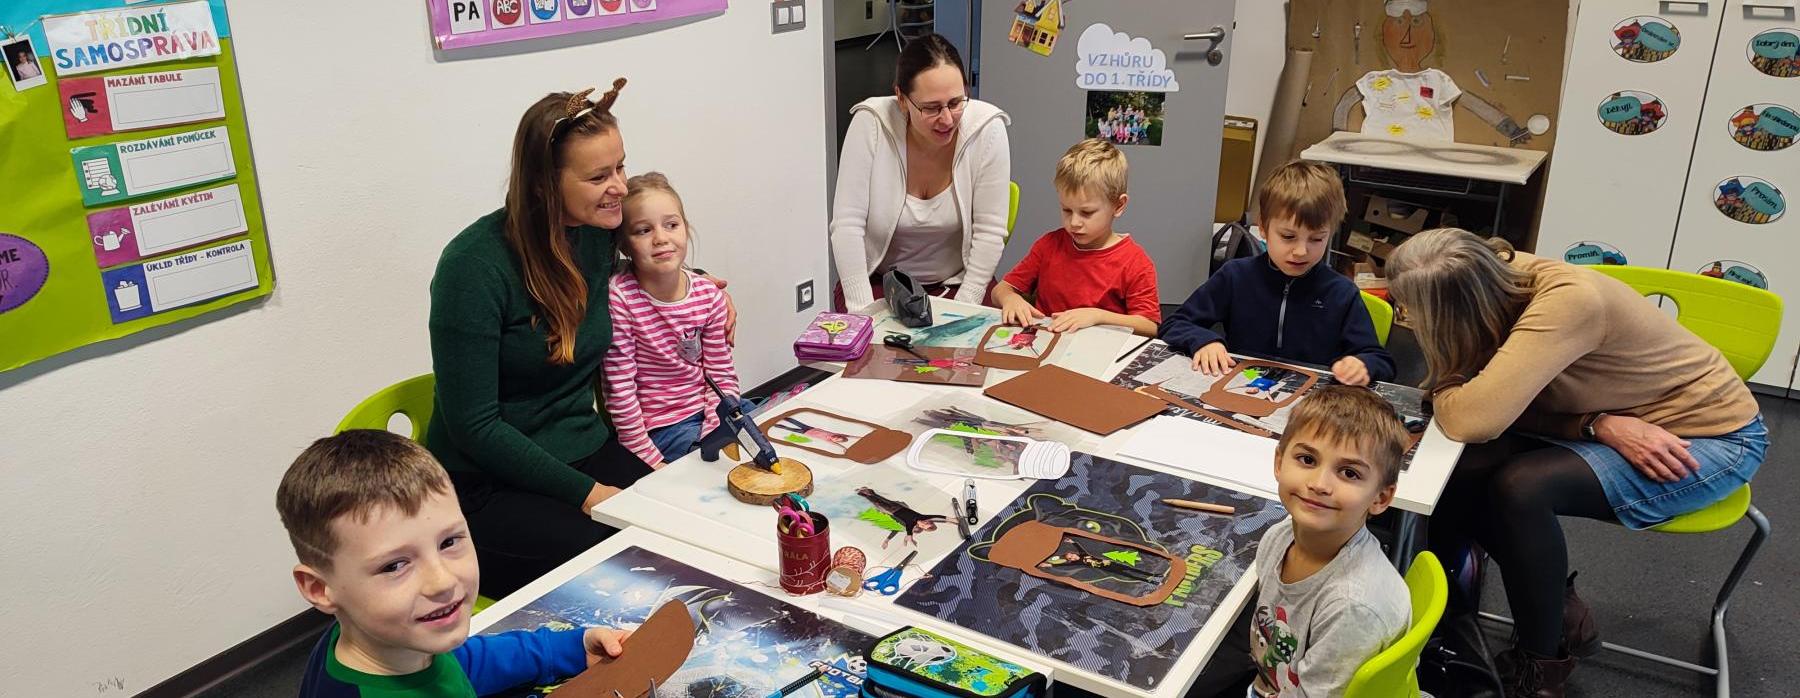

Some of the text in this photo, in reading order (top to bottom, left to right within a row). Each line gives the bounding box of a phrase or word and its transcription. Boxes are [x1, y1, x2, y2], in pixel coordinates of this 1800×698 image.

[453, 1, 480, 21] PA
[496, 0, 519, 14] ABC
[84, 8, 170, 43] TŘÍDNÍ
[56, 30, 216, 69] SAMOSPRÁVA
[1088, 52, 1153, 68] VZHŮRU
[107, 73, 183, 88] MAZÁNÍ TABULE
[1084, 70, 1172, 88] DO 1. TŘÍDY
[120, 129, 216, 153] ROZDÁVÁNÍ POMŮCEK
[133, 191, 214, 216] ZALÉVÁNÍ KVĚTIN
[146, 260, 172, 272] ÚKLID
[175, 254, 198, 266] TŘÍDY
[206, 243, 245, 259] KONTROLA
